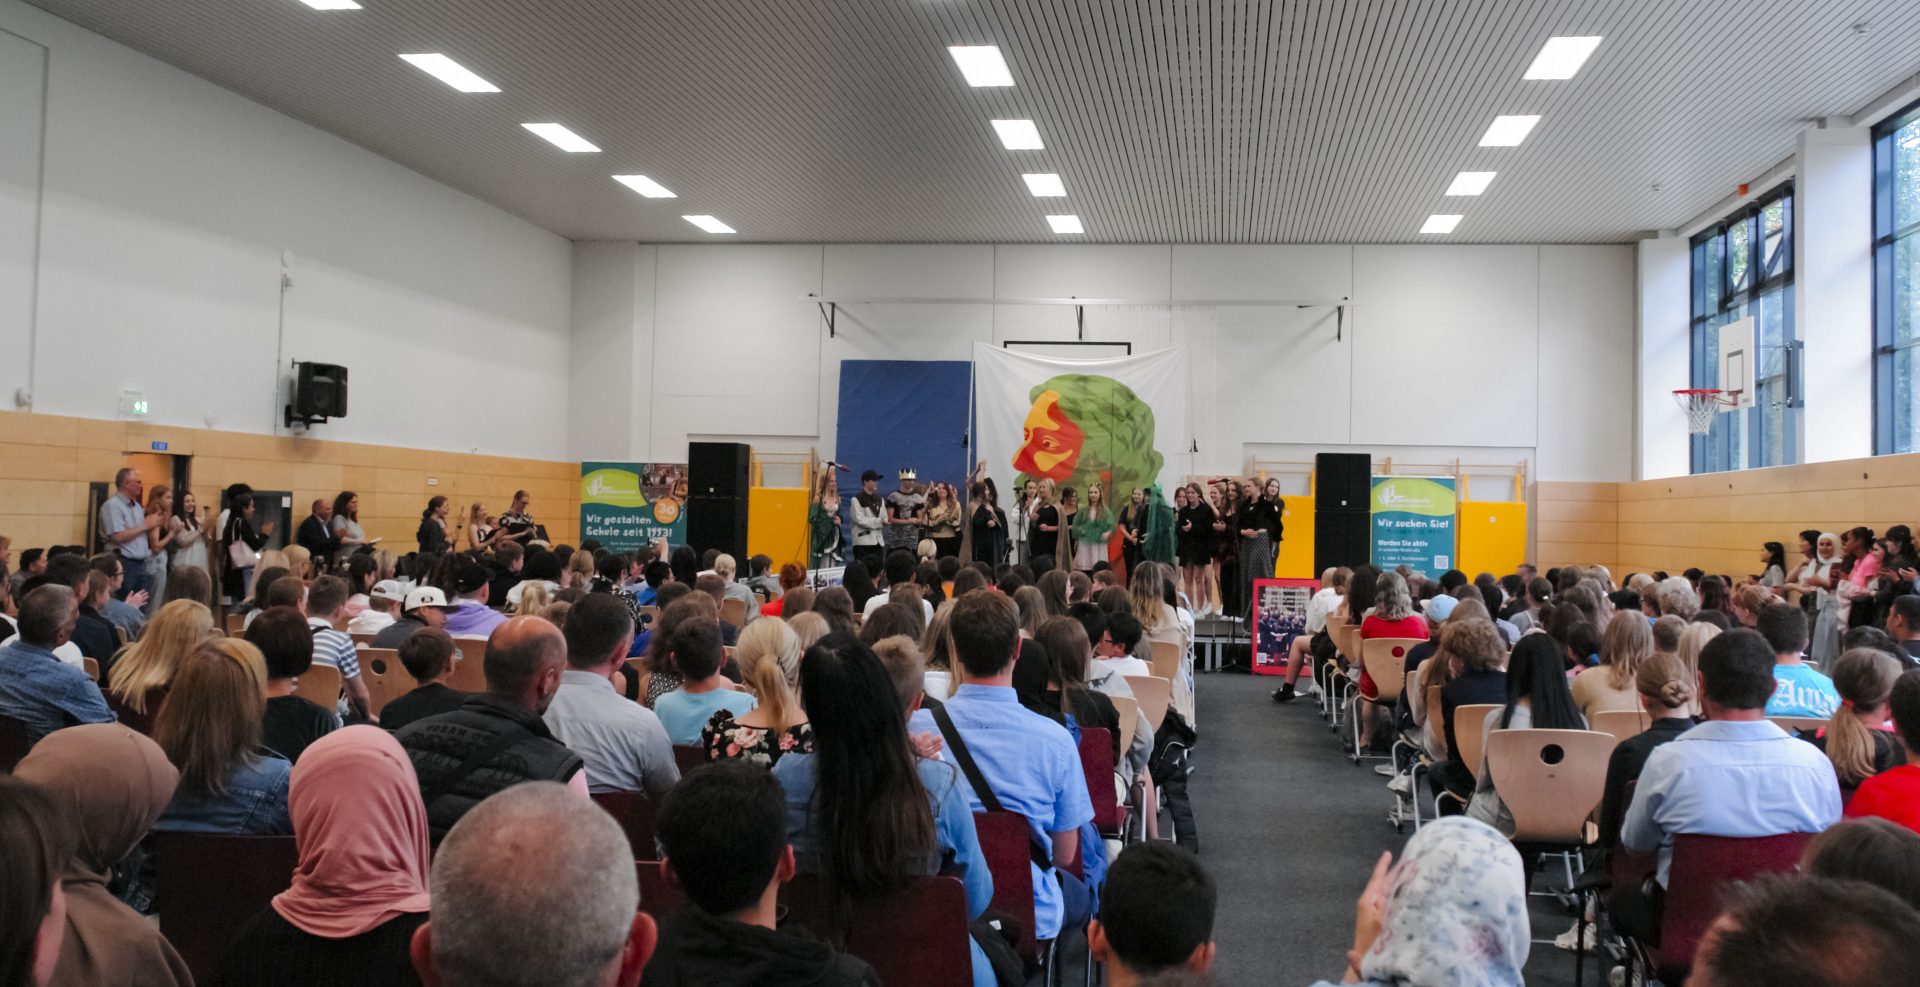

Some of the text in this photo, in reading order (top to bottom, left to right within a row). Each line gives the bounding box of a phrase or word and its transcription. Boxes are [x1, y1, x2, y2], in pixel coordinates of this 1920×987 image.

[659, 504, 675, 515] 30
[586, 514, 601, 523] Wir
[604, 515, 651, 525] gestalten
[1378, 519, 1449, 528] Wir suchen Sie!
[586, 526, 672, 538] Schule seit 1993!
